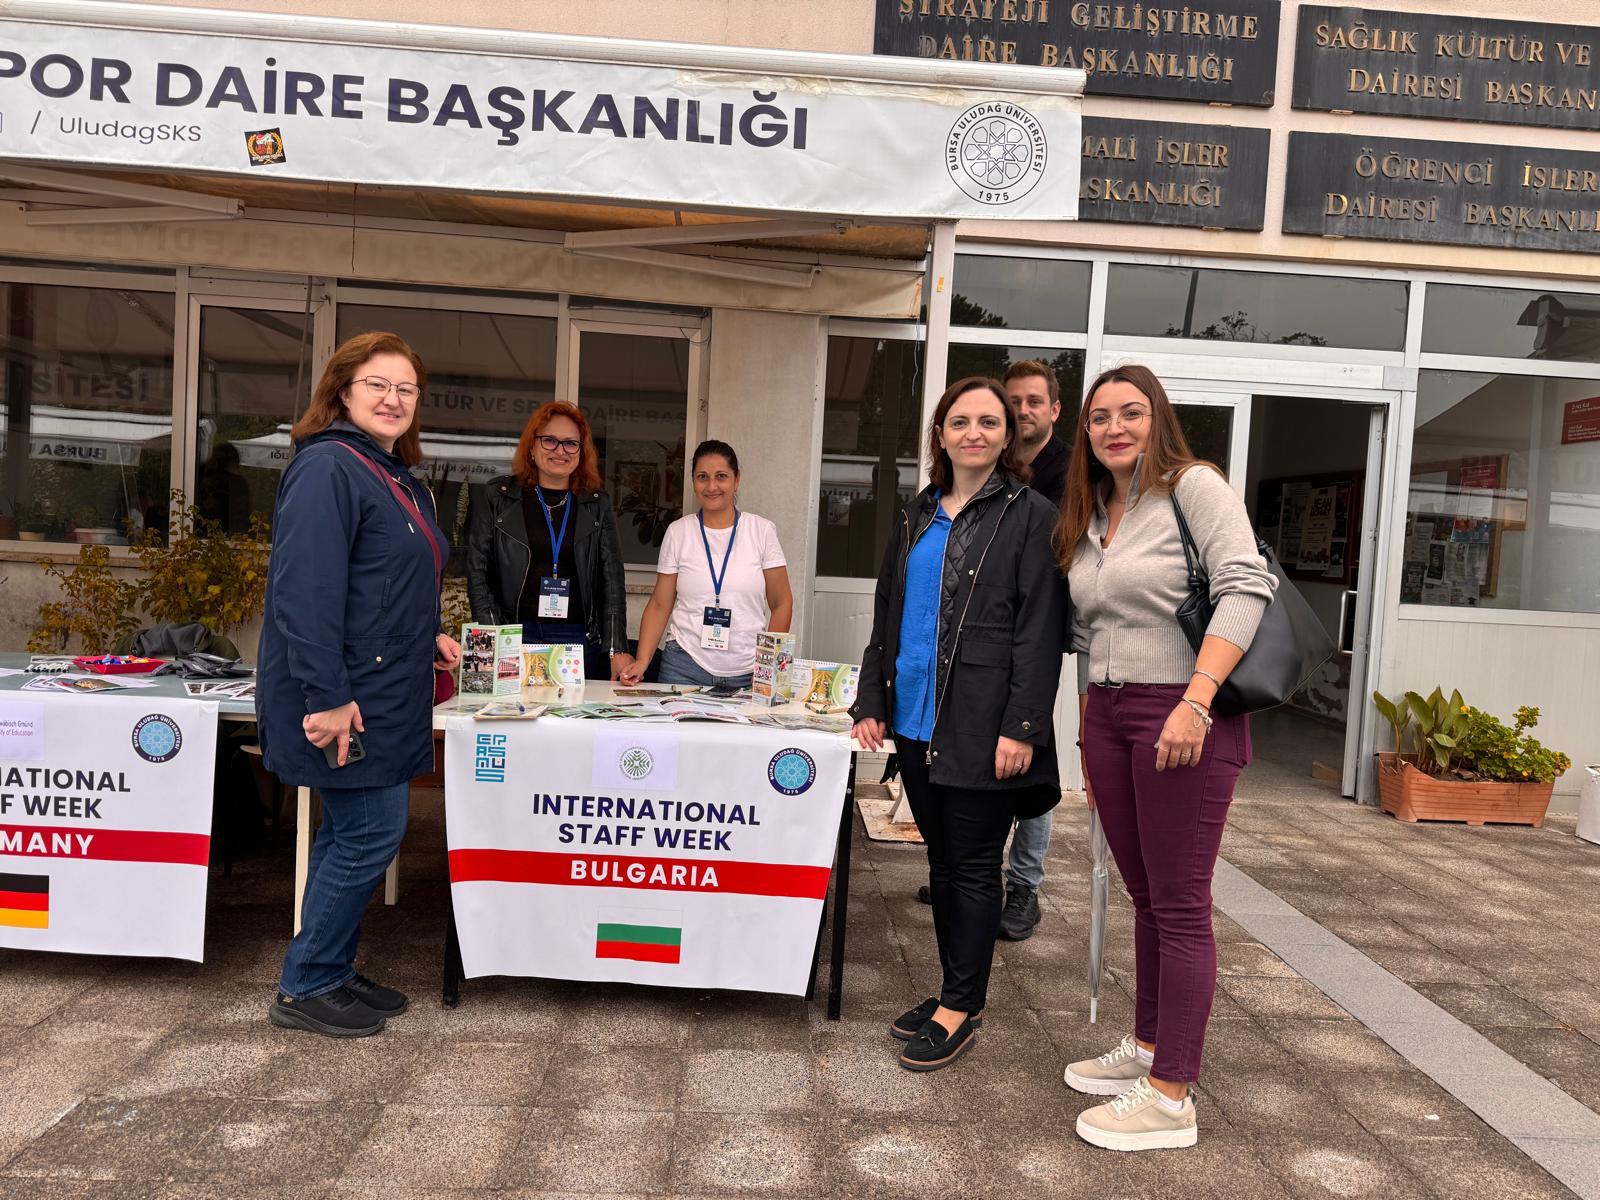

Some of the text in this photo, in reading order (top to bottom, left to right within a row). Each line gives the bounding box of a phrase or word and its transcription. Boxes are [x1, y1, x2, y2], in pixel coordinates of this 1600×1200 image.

[1071, 2, 1258, 41] GELİŞTİRME
[918, 32, 1234, 82] DAİRE BAŞKANLIĞI
[1315, 21, 1592, 67] SAĞLIK KÜLTÜR VE
[155, 57, 365, 119] DAİRE
[387, 78, 808, 151] BAŞKANLIĞI
[1347, 68, 1600, 111] DAİRESİ BAŞKAN
[59, 116, 202, 145] UludagSKS
[948, 131, 962, 172] BURSA
[958, 102, 1002, 130] ULUDAĞ
[1355, 147, 1494, 185] ÖĞRENCİ
[978, 190, 1009, 202] 1975
[1079, 177, 1222, 208] ŞKANLIĞI
[1325, 191, 1440, 223] DAİRESİ
[23, 794, 103, 819] WEEK
[533, 793, 761, 826] INTERNATIONAL
[0, 830, 94, 856] MANY
[558, 822, 732, 851] STAFF WEEK
[571, 860, 719, 888] BULGARIA
